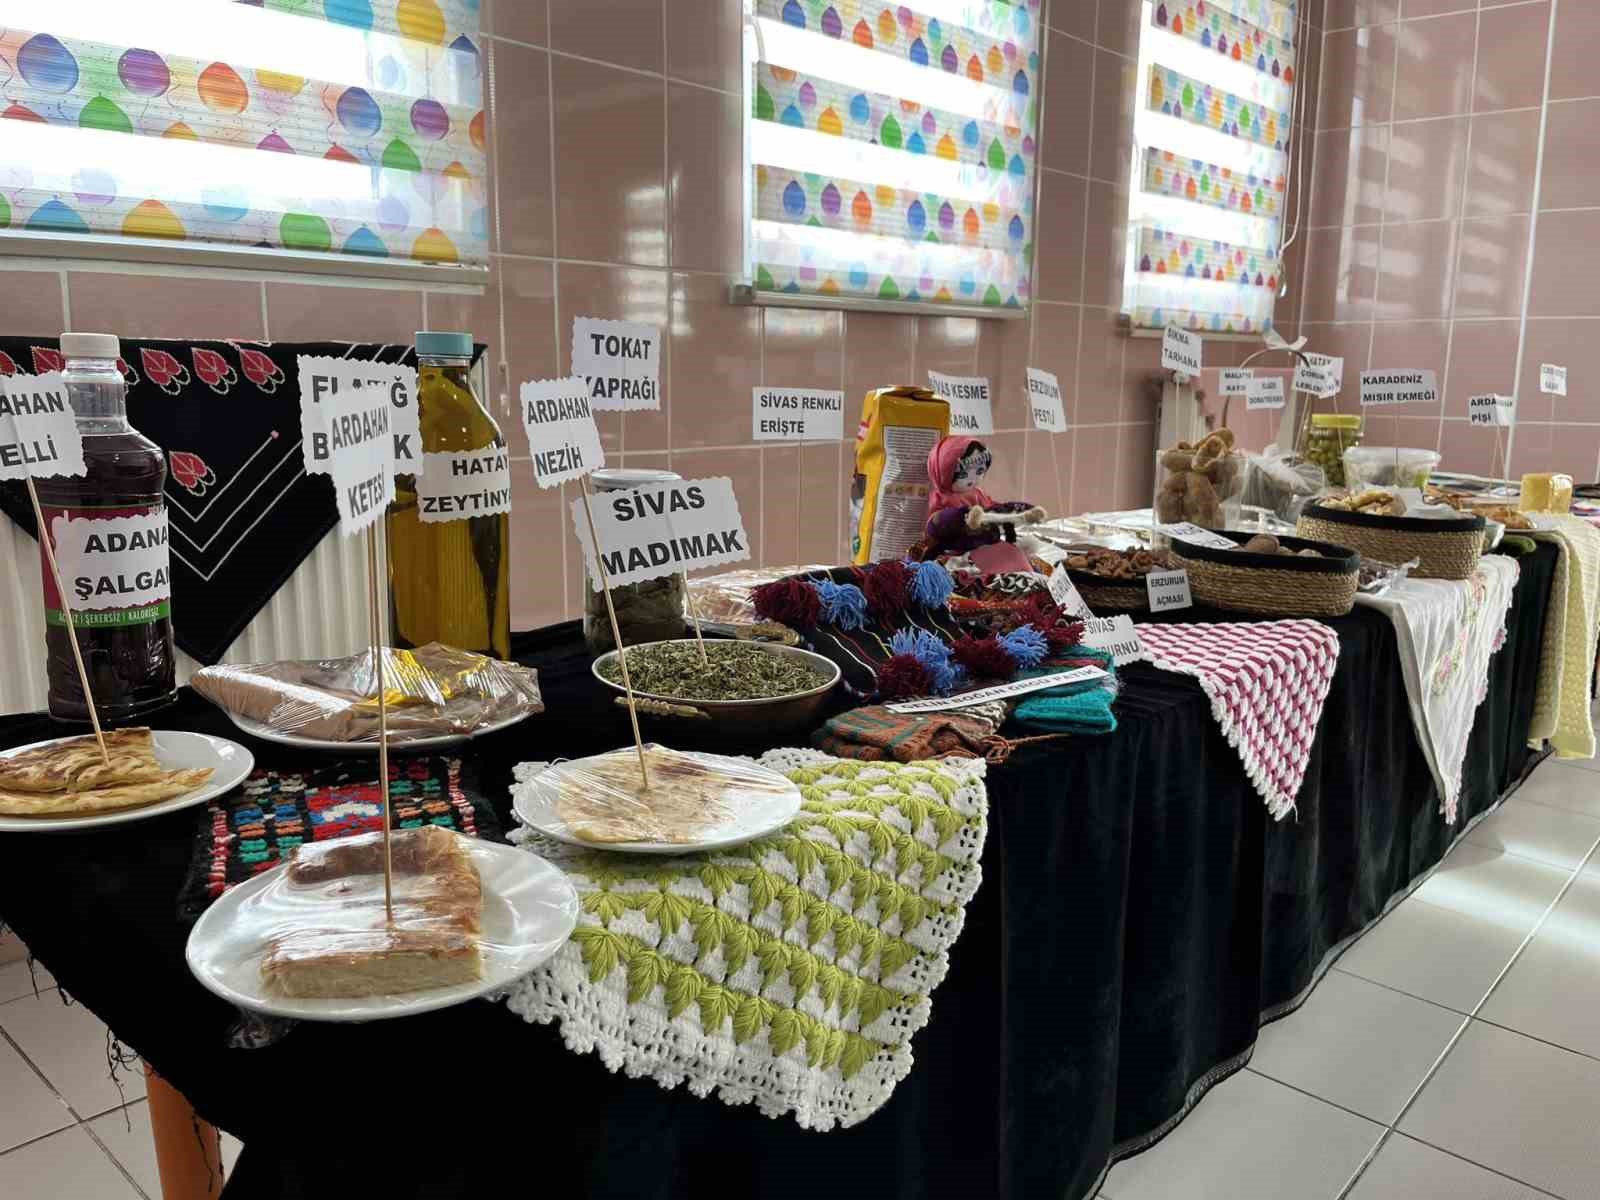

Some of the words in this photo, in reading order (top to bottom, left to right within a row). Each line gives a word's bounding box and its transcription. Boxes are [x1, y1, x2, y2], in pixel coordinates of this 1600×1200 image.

[590, 333, 651, 360] TOKAT
[1164, 348, 1198, 369] TARHANA
[1362, 373, 1423, 385] KARADENİZ
[760, 391, 798, 409] SİVAS
[802, 395, 841, 411] RENKLİ
[952, 385, 988, 400] KESME
[1362, 392, 1394, 402] MISIR
[1396, 391, 1436, 402] EKMEĞİ
[527, 396, 591, 425] ARDAHAN
[1471, 411, 1492, 424] PİŞİ
[332, 404, 388, 450] ARDAHAN
[760, 416, 805, 436] ERİŞTE
[534, 442, 584, 477] NEZİH
[348, 463, 385, 518] KETESİ
[612, 486, 706, 522] SİVAS
[84, 525, 168, 554] ADANA
[601, 528, 744, 577] MADIMAK
[1150, 575, 1185, 588] ERZURUM
[1156, 594, 1185, 607] AÇMASI
[1087, 618, 1116, 634] SİVAS
